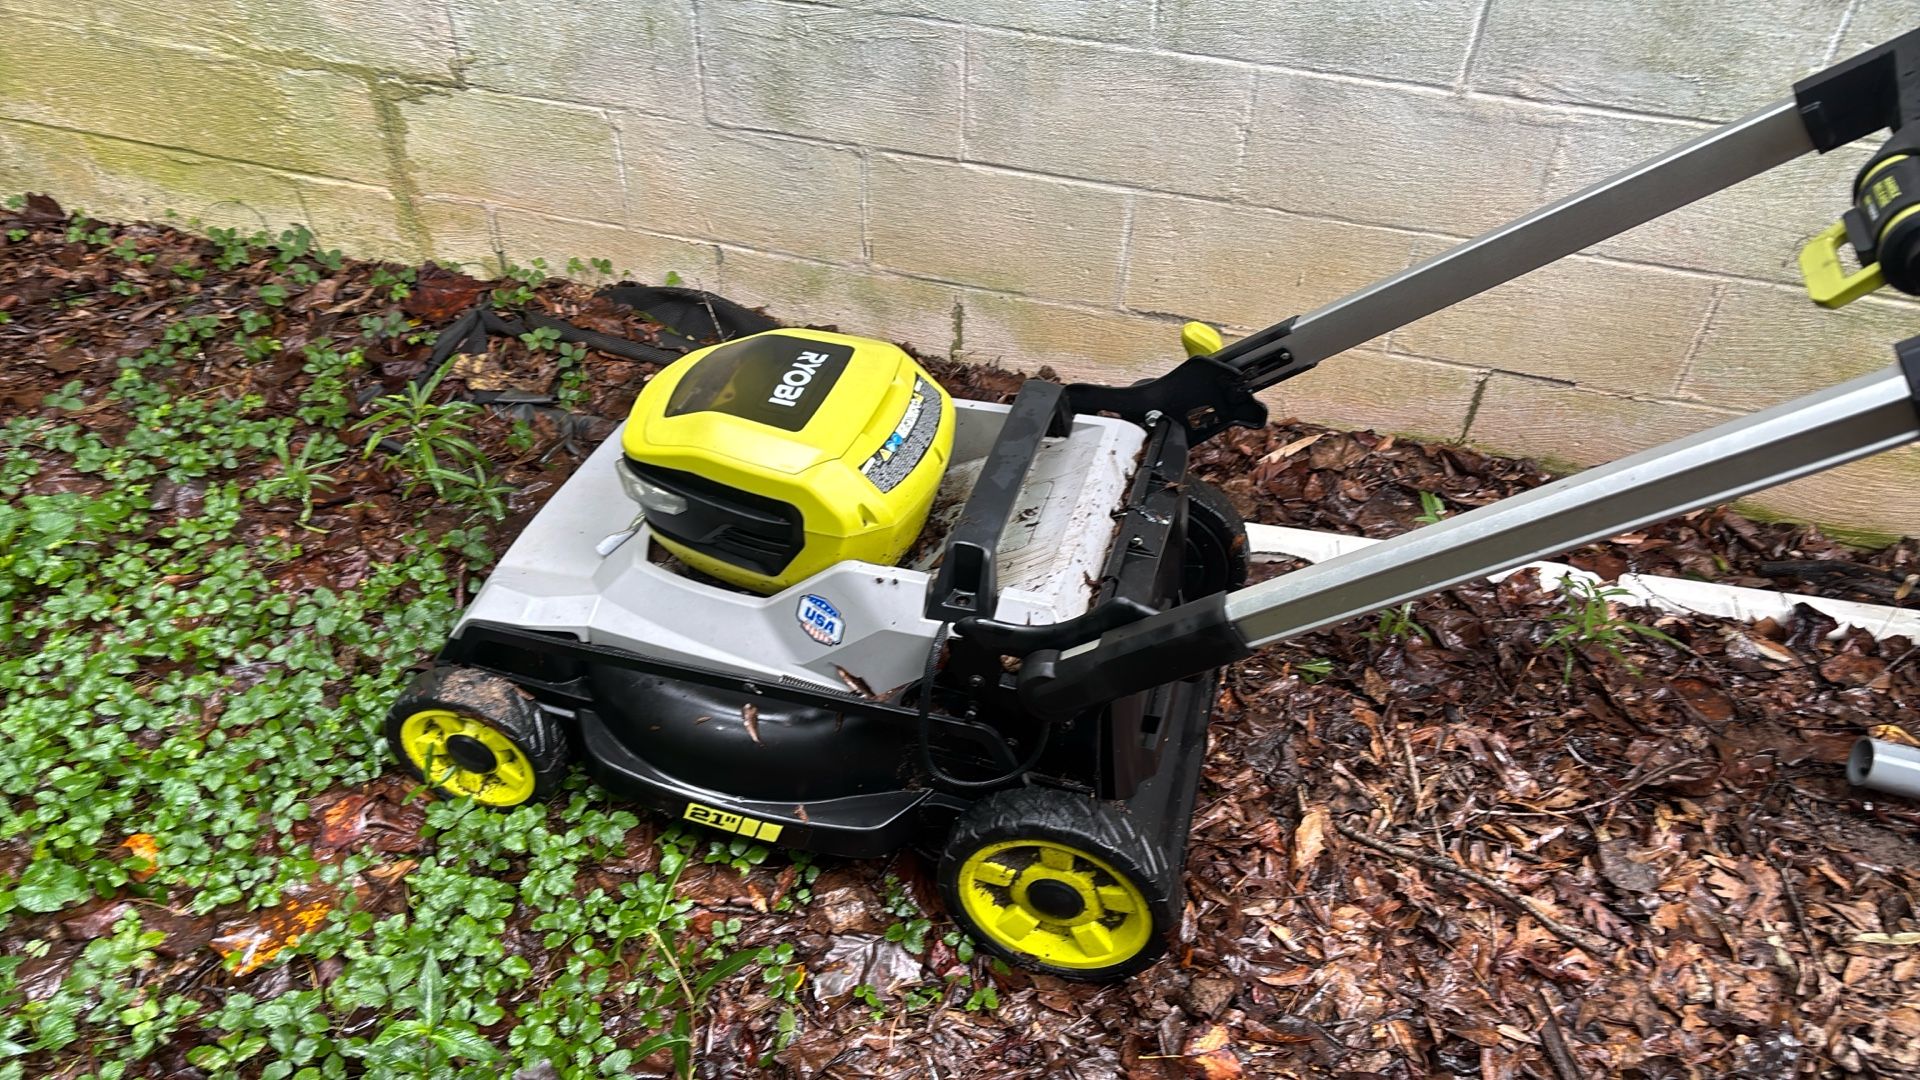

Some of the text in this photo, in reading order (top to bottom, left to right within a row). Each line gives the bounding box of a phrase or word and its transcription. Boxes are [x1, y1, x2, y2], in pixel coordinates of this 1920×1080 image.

[768, 351, 830, 407] RYOBI
[804, 606, 835, 634] USA
[689, 806, 737, 827] 21"
